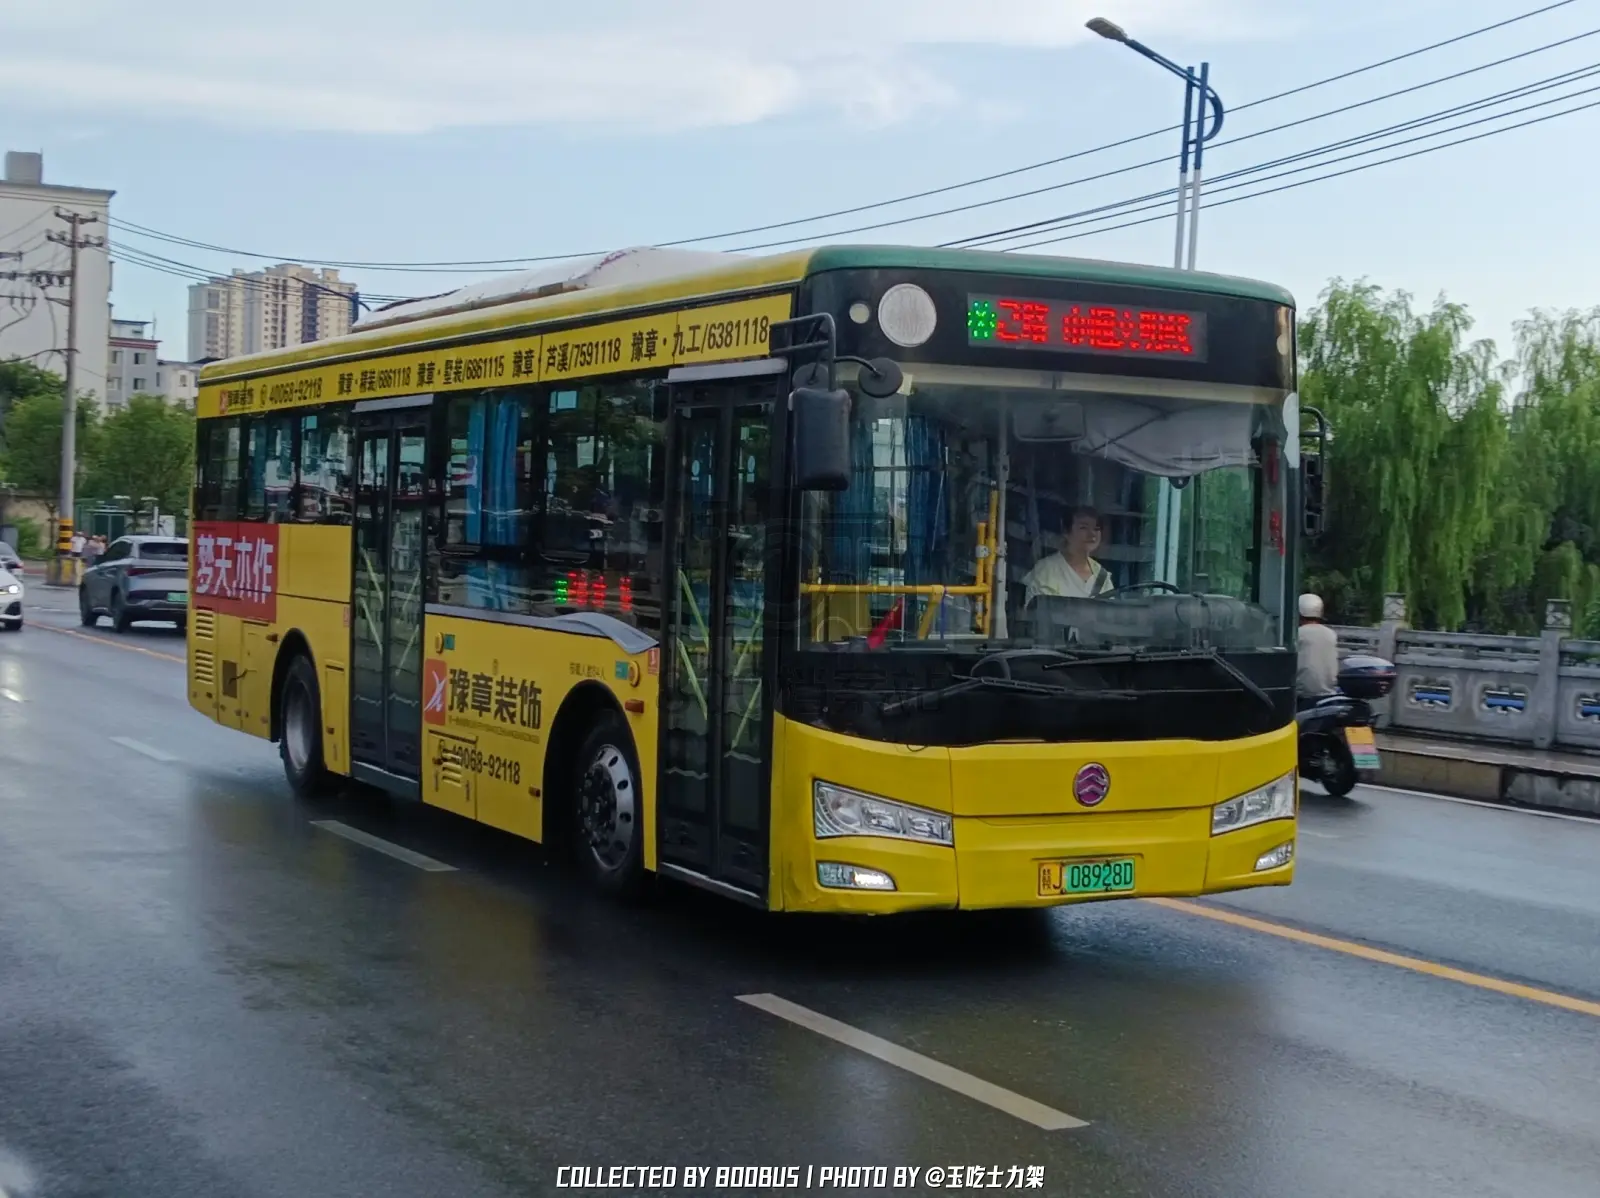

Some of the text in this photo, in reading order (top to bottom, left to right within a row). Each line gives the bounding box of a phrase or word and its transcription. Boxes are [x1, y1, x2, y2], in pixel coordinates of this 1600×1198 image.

[195, 533, 274, 605] 梦天木作
[447, 668, 543, 730] 豫章装饰
